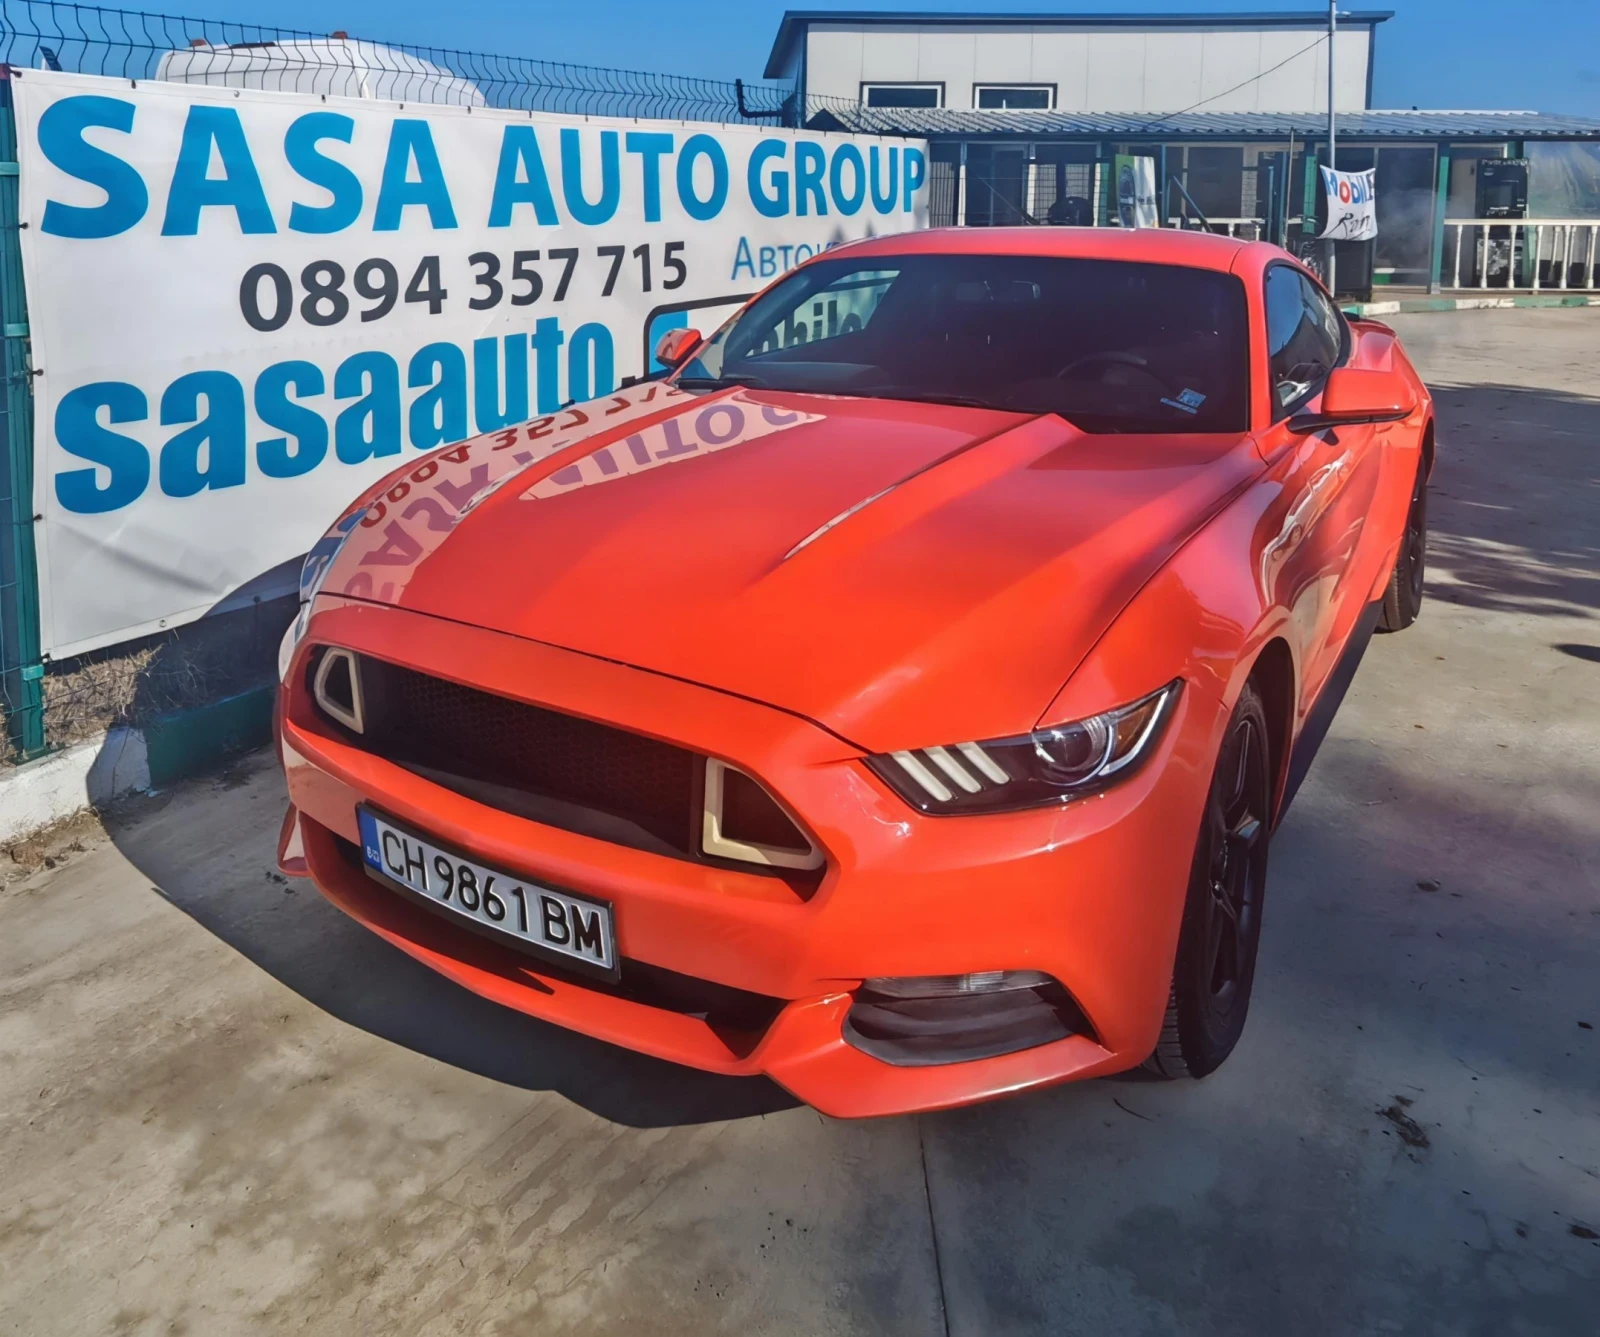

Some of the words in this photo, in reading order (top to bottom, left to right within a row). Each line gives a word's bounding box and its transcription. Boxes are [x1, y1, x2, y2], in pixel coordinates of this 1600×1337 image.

[38, 95, 458, 239] SASA
[488, 125, 728, 227] AUTO
[748, 139, 925, 218] GROUP
[239, 255, 447, 331] 0894
[468, 247, 579, 310] 357
[597, 241, 687, 296] 715
